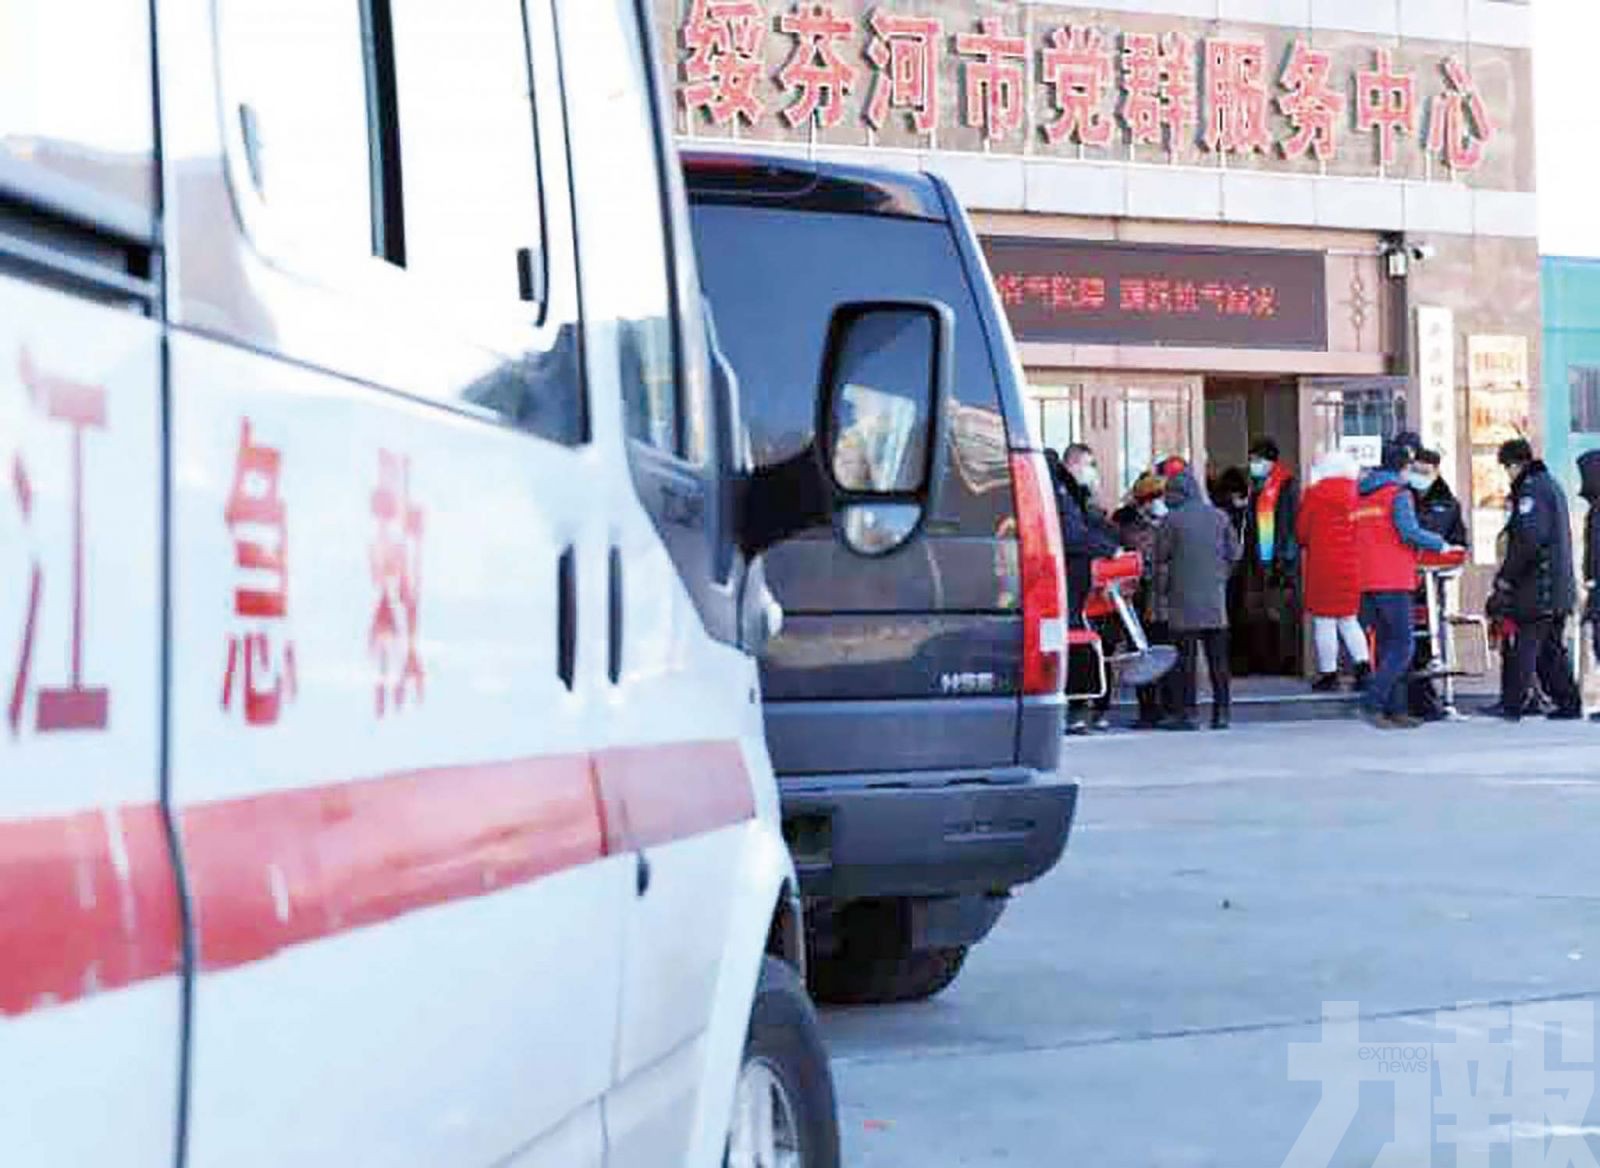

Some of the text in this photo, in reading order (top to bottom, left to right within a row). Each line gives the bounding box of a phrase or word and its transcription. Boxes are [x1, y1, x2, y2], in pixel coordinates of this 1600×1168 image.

[682, 0, 1495, 170] 绥芬河市党群服务中心
